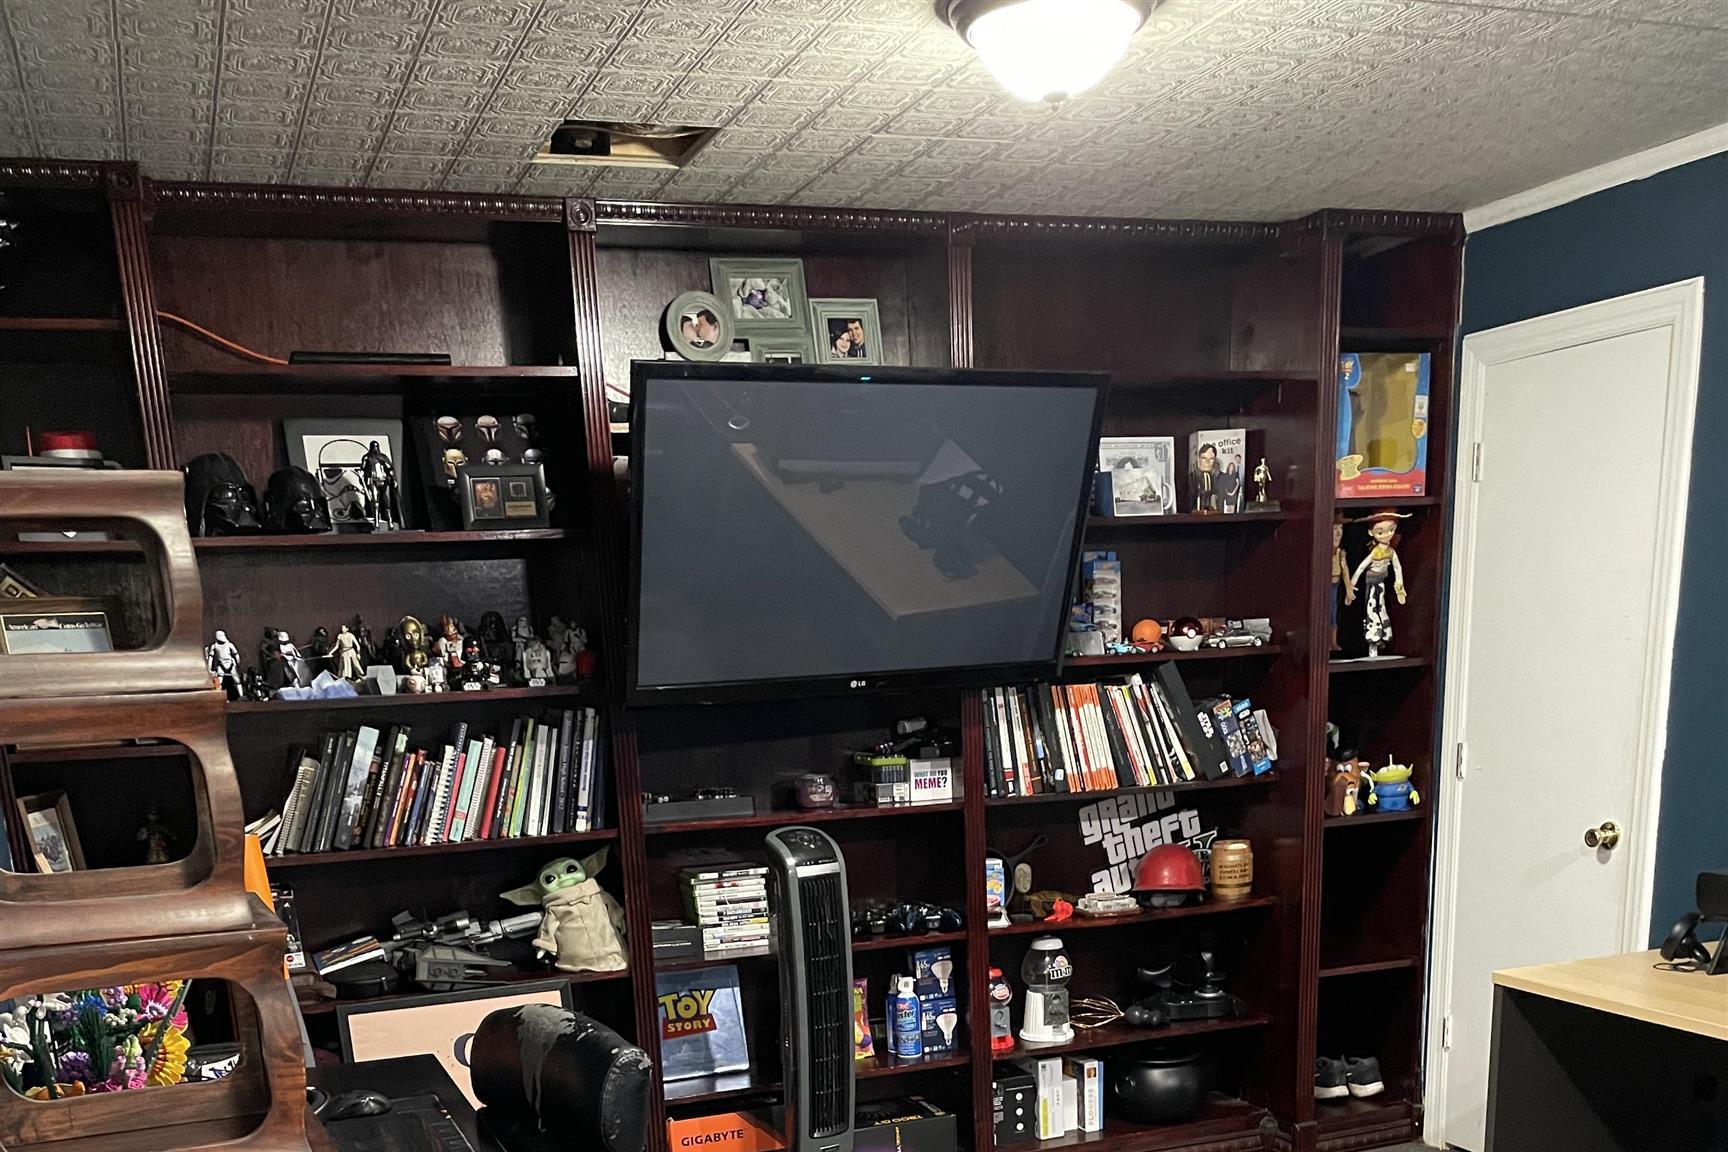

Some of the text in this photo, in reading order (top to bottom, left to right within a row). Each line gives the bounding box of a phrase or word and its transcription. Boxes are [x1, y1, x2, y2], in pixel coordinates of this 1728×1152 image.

[1218, 438, 1241, 447] office
[914, 776, 948, 790] MEME?
[1101, 809, 1201, 866] theft
[658, 989, 714, 1020] TOY
[667, 1018, 711, 1033] STORY
[681, 1129, 744, 1147] GIGABYTE
